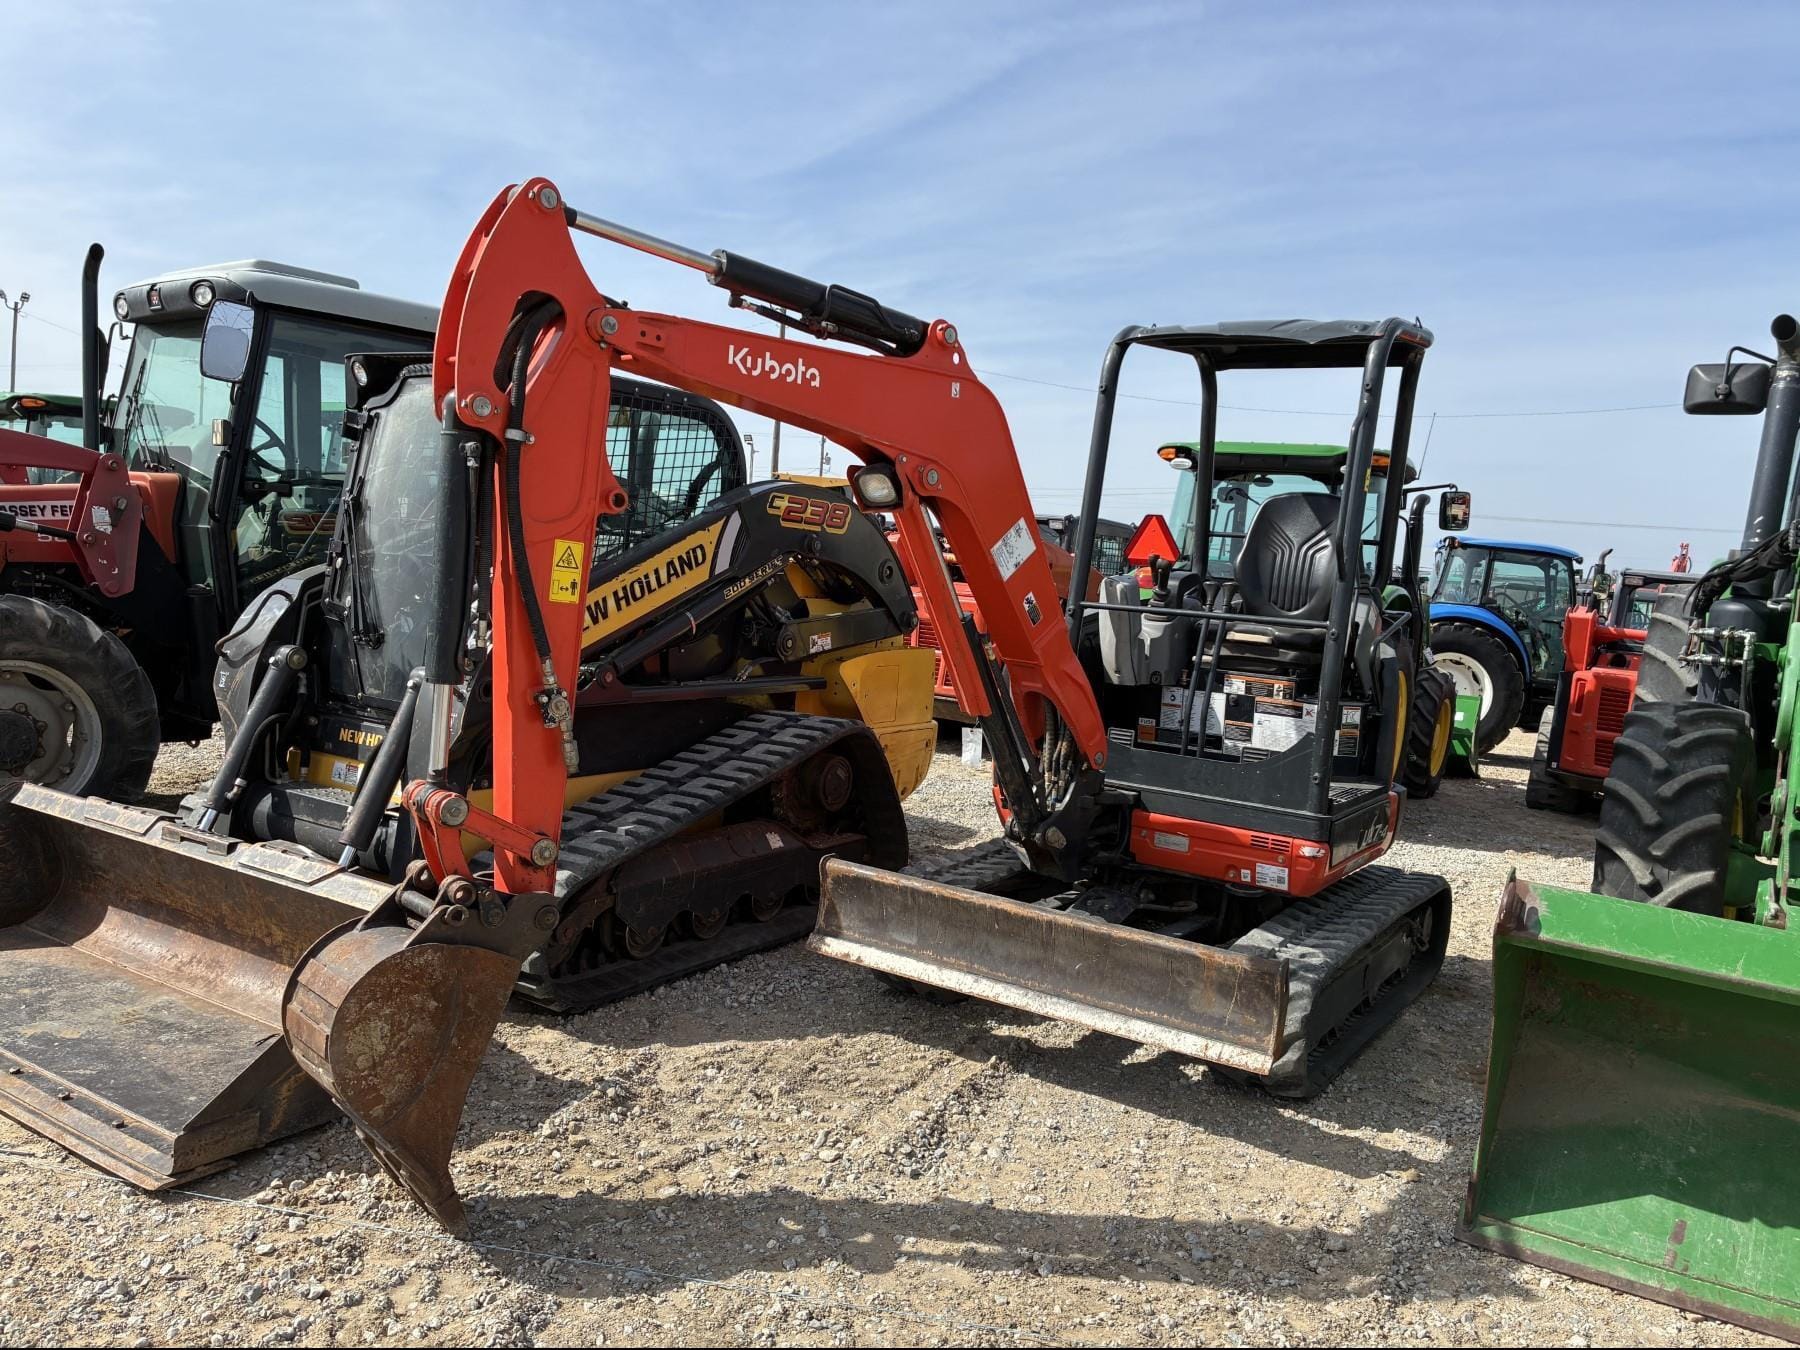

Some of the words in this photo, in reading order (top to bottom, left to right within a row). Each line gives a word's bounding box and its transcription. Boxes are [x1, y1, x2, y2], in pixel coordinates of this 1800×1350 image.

[727, 344, 821, 387] Kubota
[767, 493, 851, 532] C238
[612, 543, 707, 612] HOLLAND
[339, 727, 366, 745] NEW
[362, 732, 384, 747] HO
